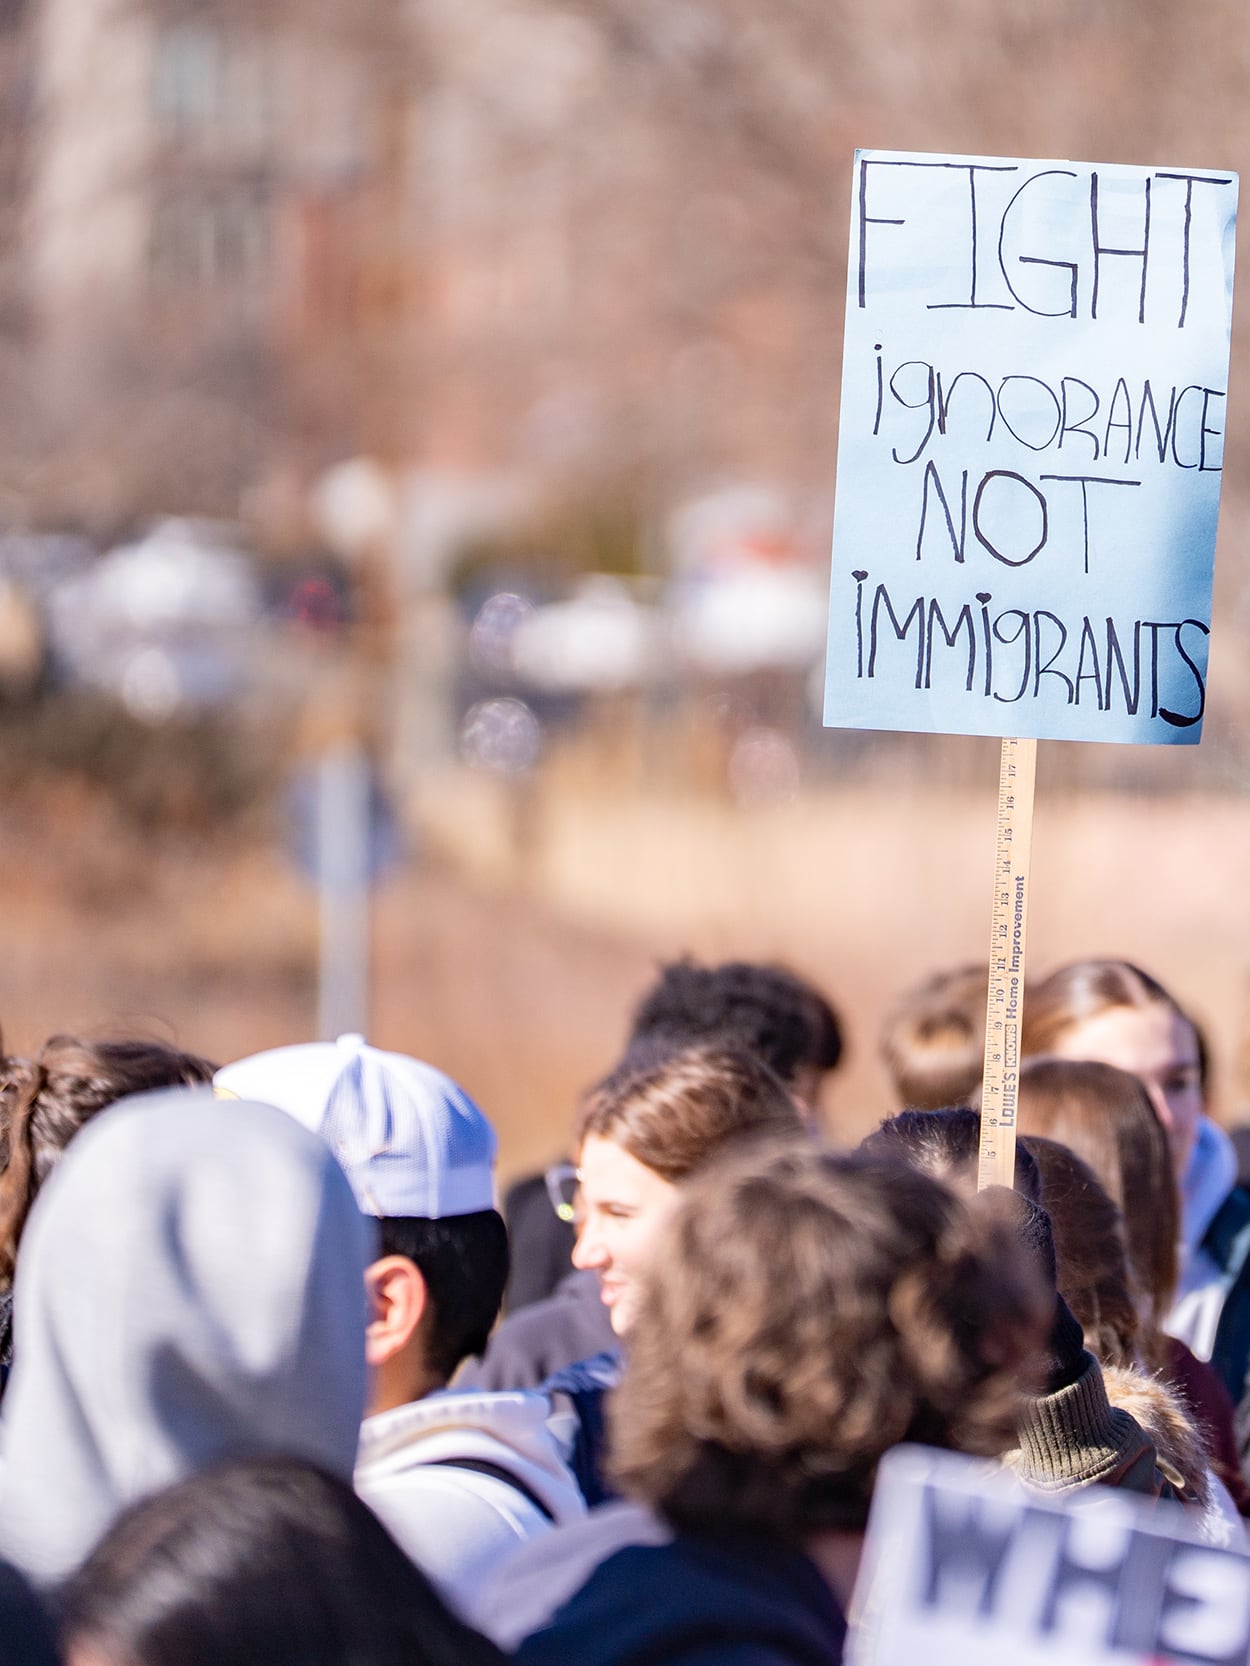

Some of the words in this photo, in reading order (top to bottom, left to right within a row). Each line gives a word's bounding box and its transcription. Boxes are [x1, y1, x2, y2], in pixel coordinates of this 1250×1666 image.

[858, 159, 1233, 329] FIGHT
[915, 459, 1141, 574] NOT
[1008, 764, 1017, 778] 17
[1006, 796, 1015, 810] 16
[1004, 828, 1013, 842] 15
[1002, 860, 1011, 874] 14
[1001, 892, 1010, 906] 13
[999, 924, 1008, 938] 12
[1008, 875, 1025, 973] Improvement
[997, 957, 1006, 971] 11
[996, 989, 1005, 1003] 10
[1006, 977, 1019, 1020] Home
[1004, 1025, 1017, 1067] KNOWS
[999, 1072, 1016, 1127] LOWE'S
